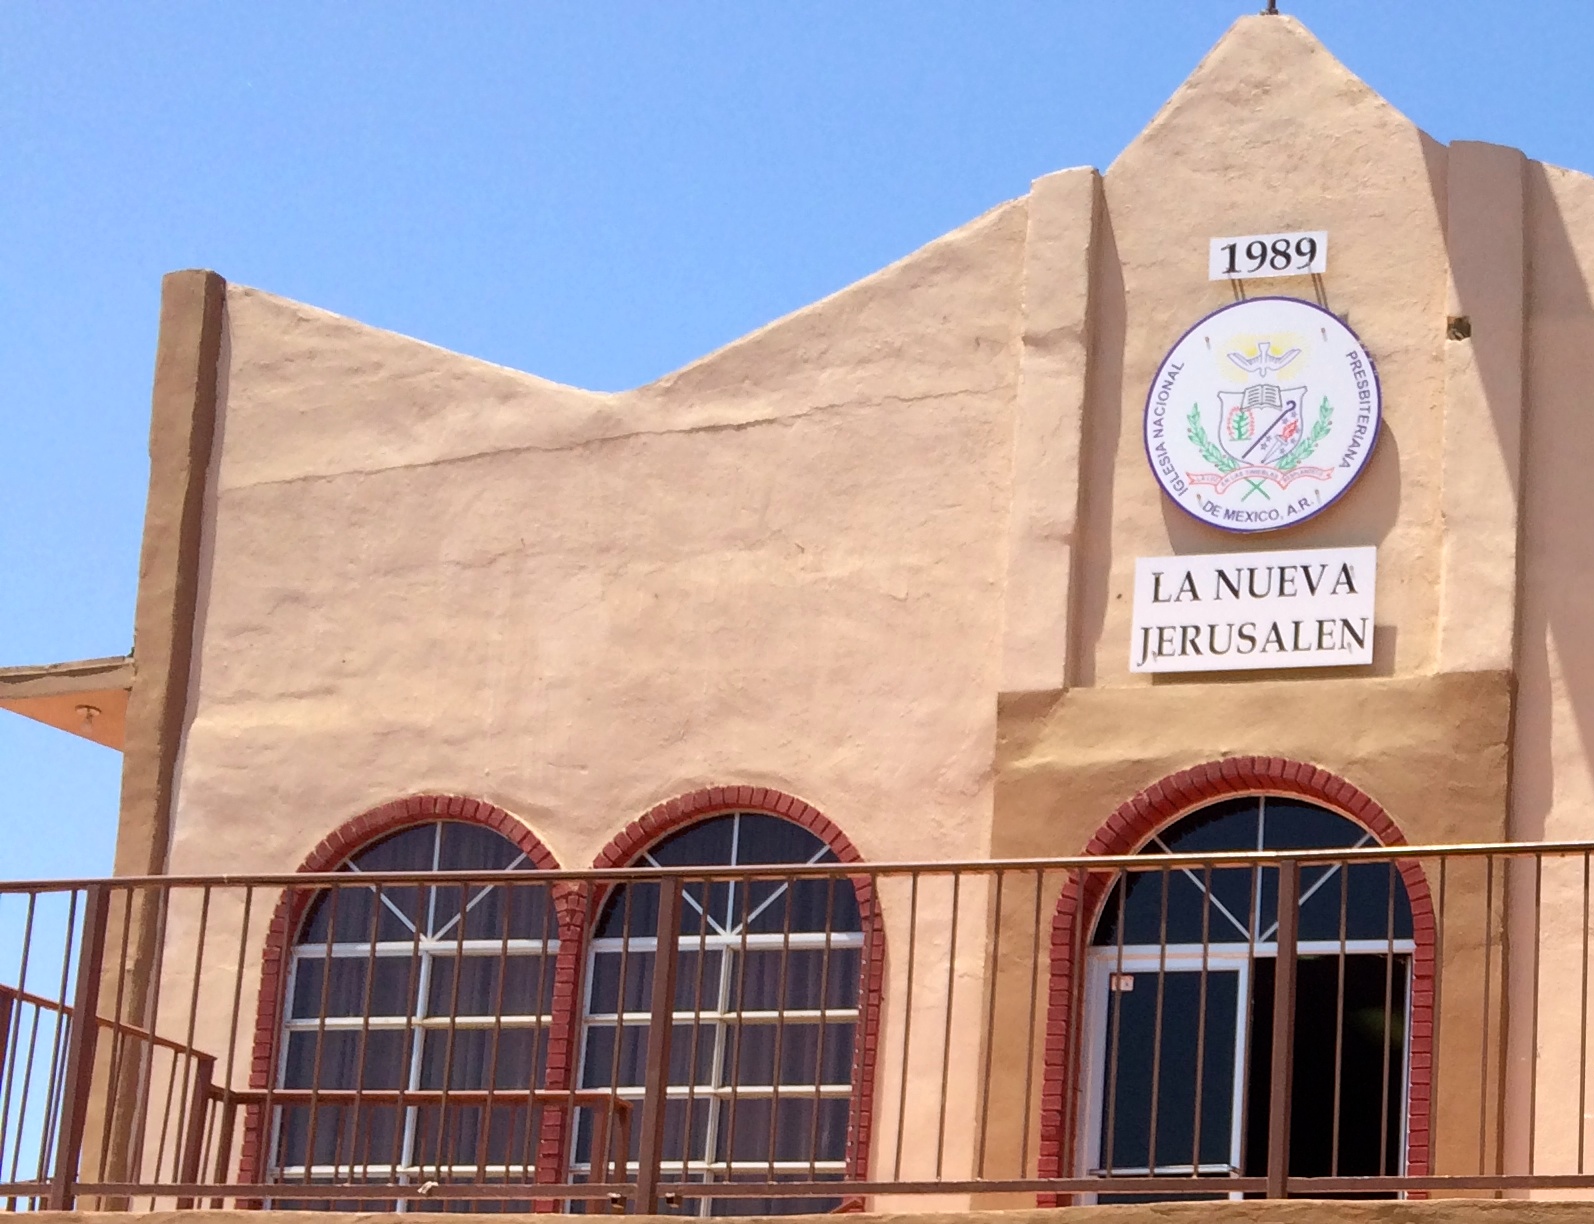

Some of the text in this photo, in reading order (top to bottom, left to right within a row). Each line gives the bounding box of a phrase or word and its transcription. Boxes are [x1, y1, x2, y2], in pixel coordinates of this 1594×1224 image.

[1221, 237, 1317, 274] 1989
[1153, 362, 1189, 497] IGLESIA NACIONAL
[1338, 350, 1371, 468] PRESBITERIANA
[1202, 500, 1221, 517] DE
[1152, 562, 1359, 603] LA NUEVA
[1136, 617, 1369, 667] JERUSALEN
